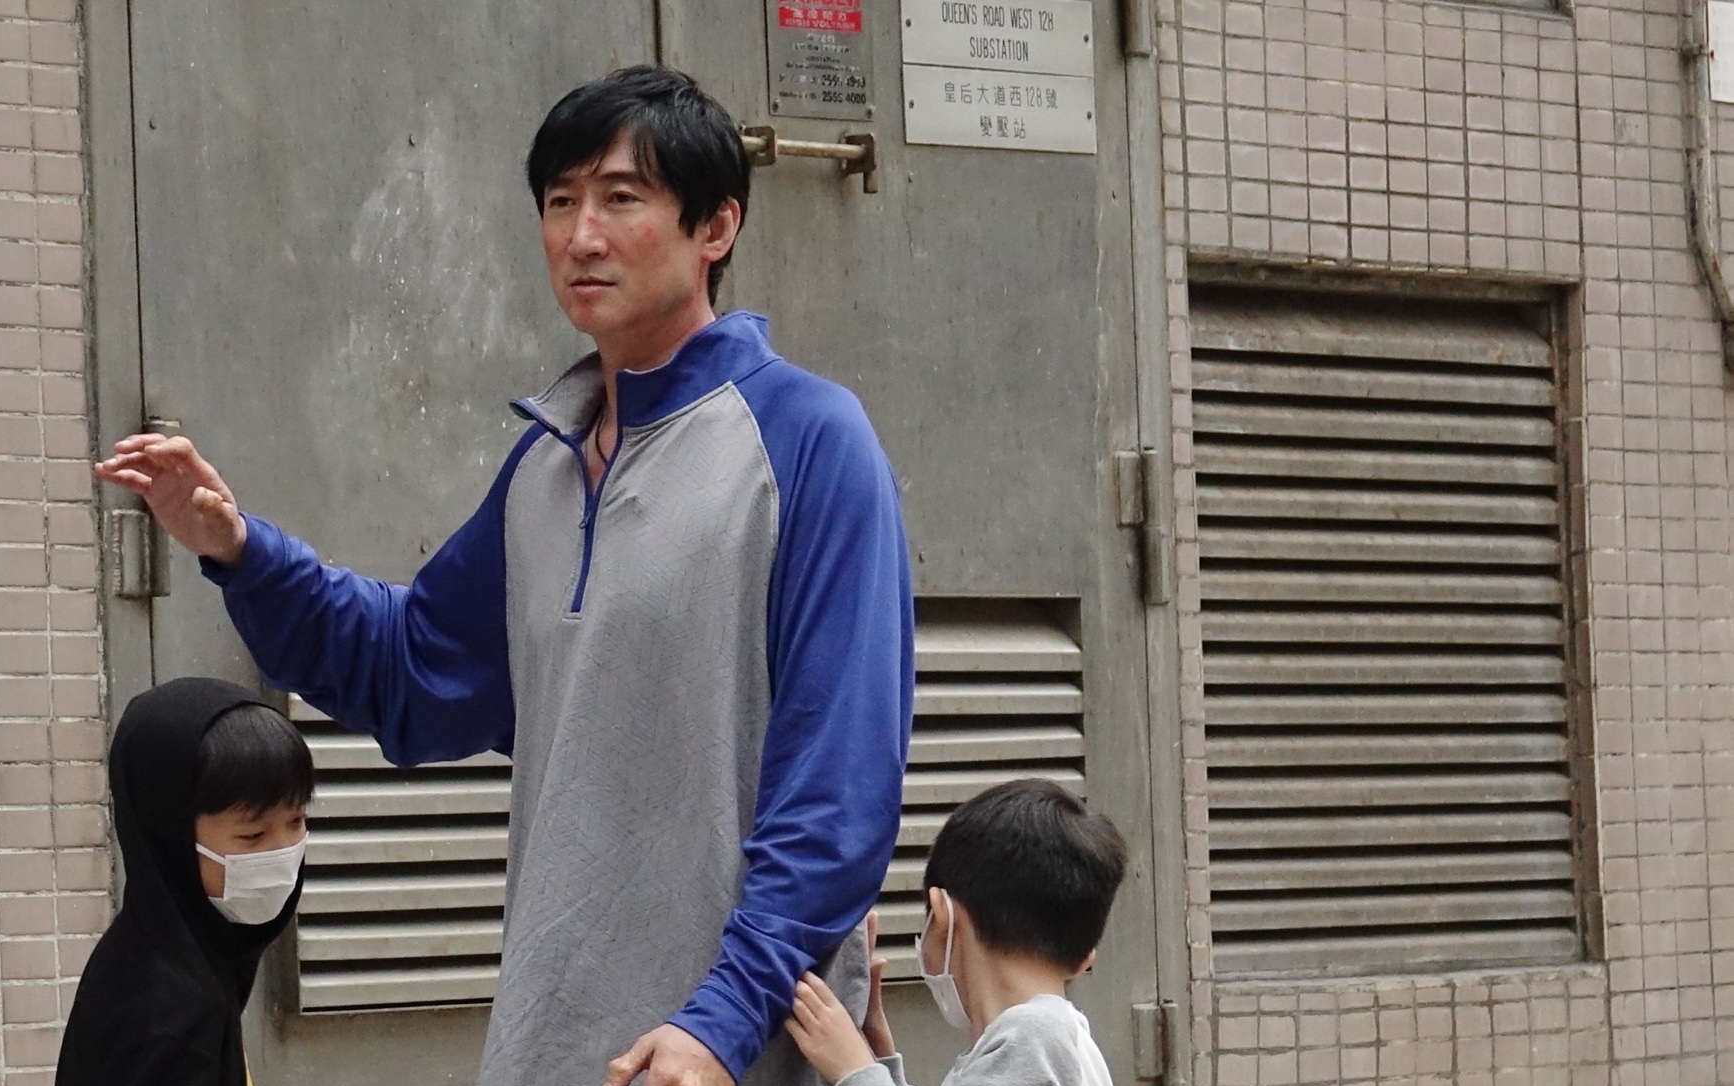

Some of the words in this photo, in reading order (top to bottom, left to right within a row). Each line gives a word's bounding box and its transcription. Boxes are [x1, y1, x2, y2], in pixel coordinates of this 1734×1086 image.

[941, 2, 978, 25] QUEEN'S
[982, 5, 1005, 28] ROAD
[1009, 7, 1033, 30] WEST
[1038, 10, 1054, 32] 128
[969, 36, 1029, 62] SUBSTATION
[979, 115, 1026, 139] 變壓站
